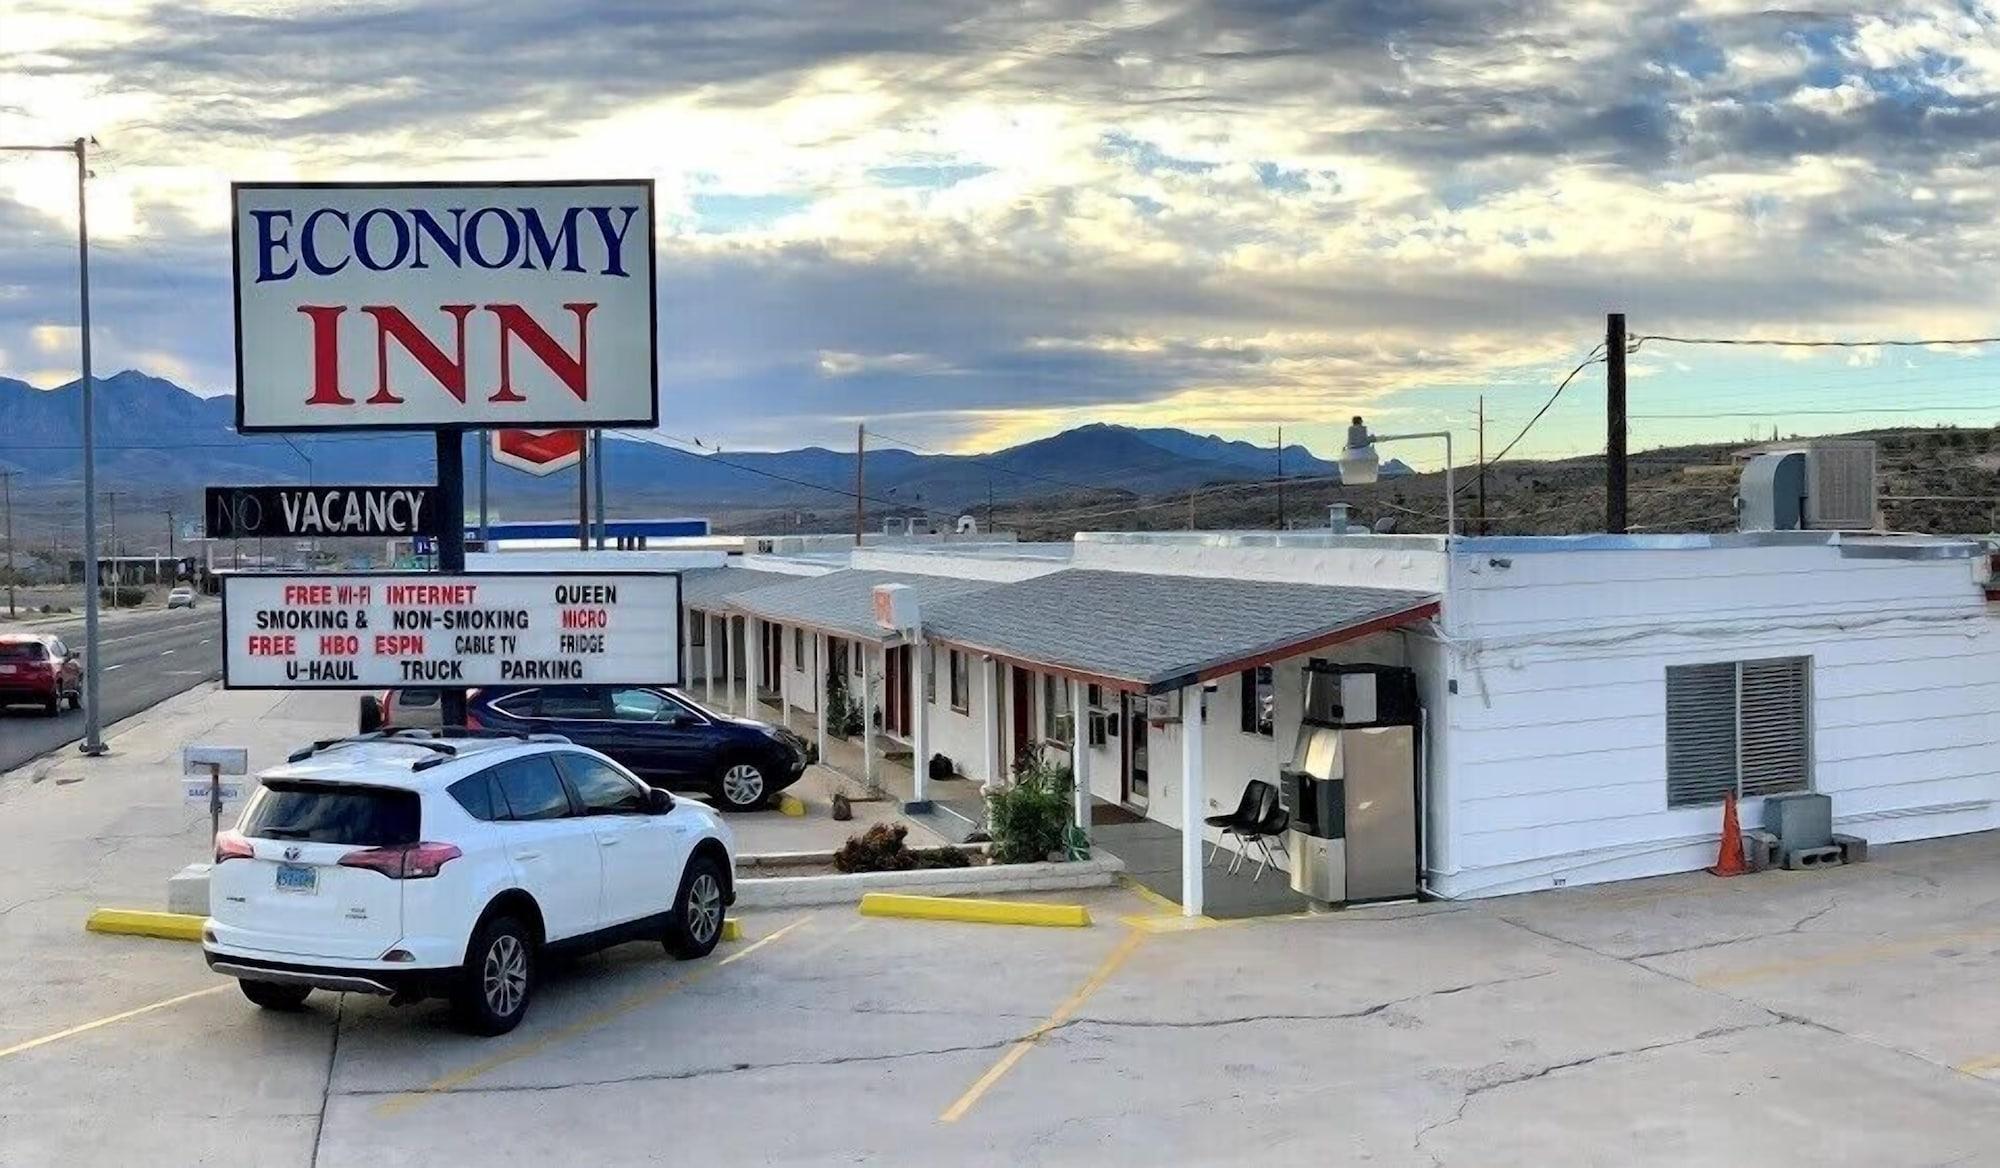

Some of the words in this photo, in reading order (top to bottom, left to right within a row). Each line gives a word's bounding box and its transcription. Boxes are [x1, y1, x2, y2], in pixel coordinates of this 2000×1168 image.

[250, 206, 639, 284] ECONOMY
[297, 302, 599, 406] INN
[217, 493, 263, 532] NO
[280, 490, 425, 533] VACANCY
[285, 585, 332, 605] FREE
[337, 585, 371, 605] WI-FI
[386, 585, 477, 605] INTERNET
[555, 585, 617, 605] QUEEN
[256, 610, 348, 629] SMOKING
[355, 610, 368, 628] &
[393, 610, 529, 629] NON-SMOKING
[562, 609, 608, 628] MICRO
[248, 635, 296, 655] FREE
[319, 635, 359, 655] HBO
[375, 635, 424, 655] ESPN
[455, 635, 496, 655] CABLE
[501, 635, 516, 654] TV
[560, 634, 605, 653] FRIDGE
[286, 660, 359, 680] U-HAUL
[401, 660, 463, 680] TRUCK
[501, 660, 583, 679] PARKING
